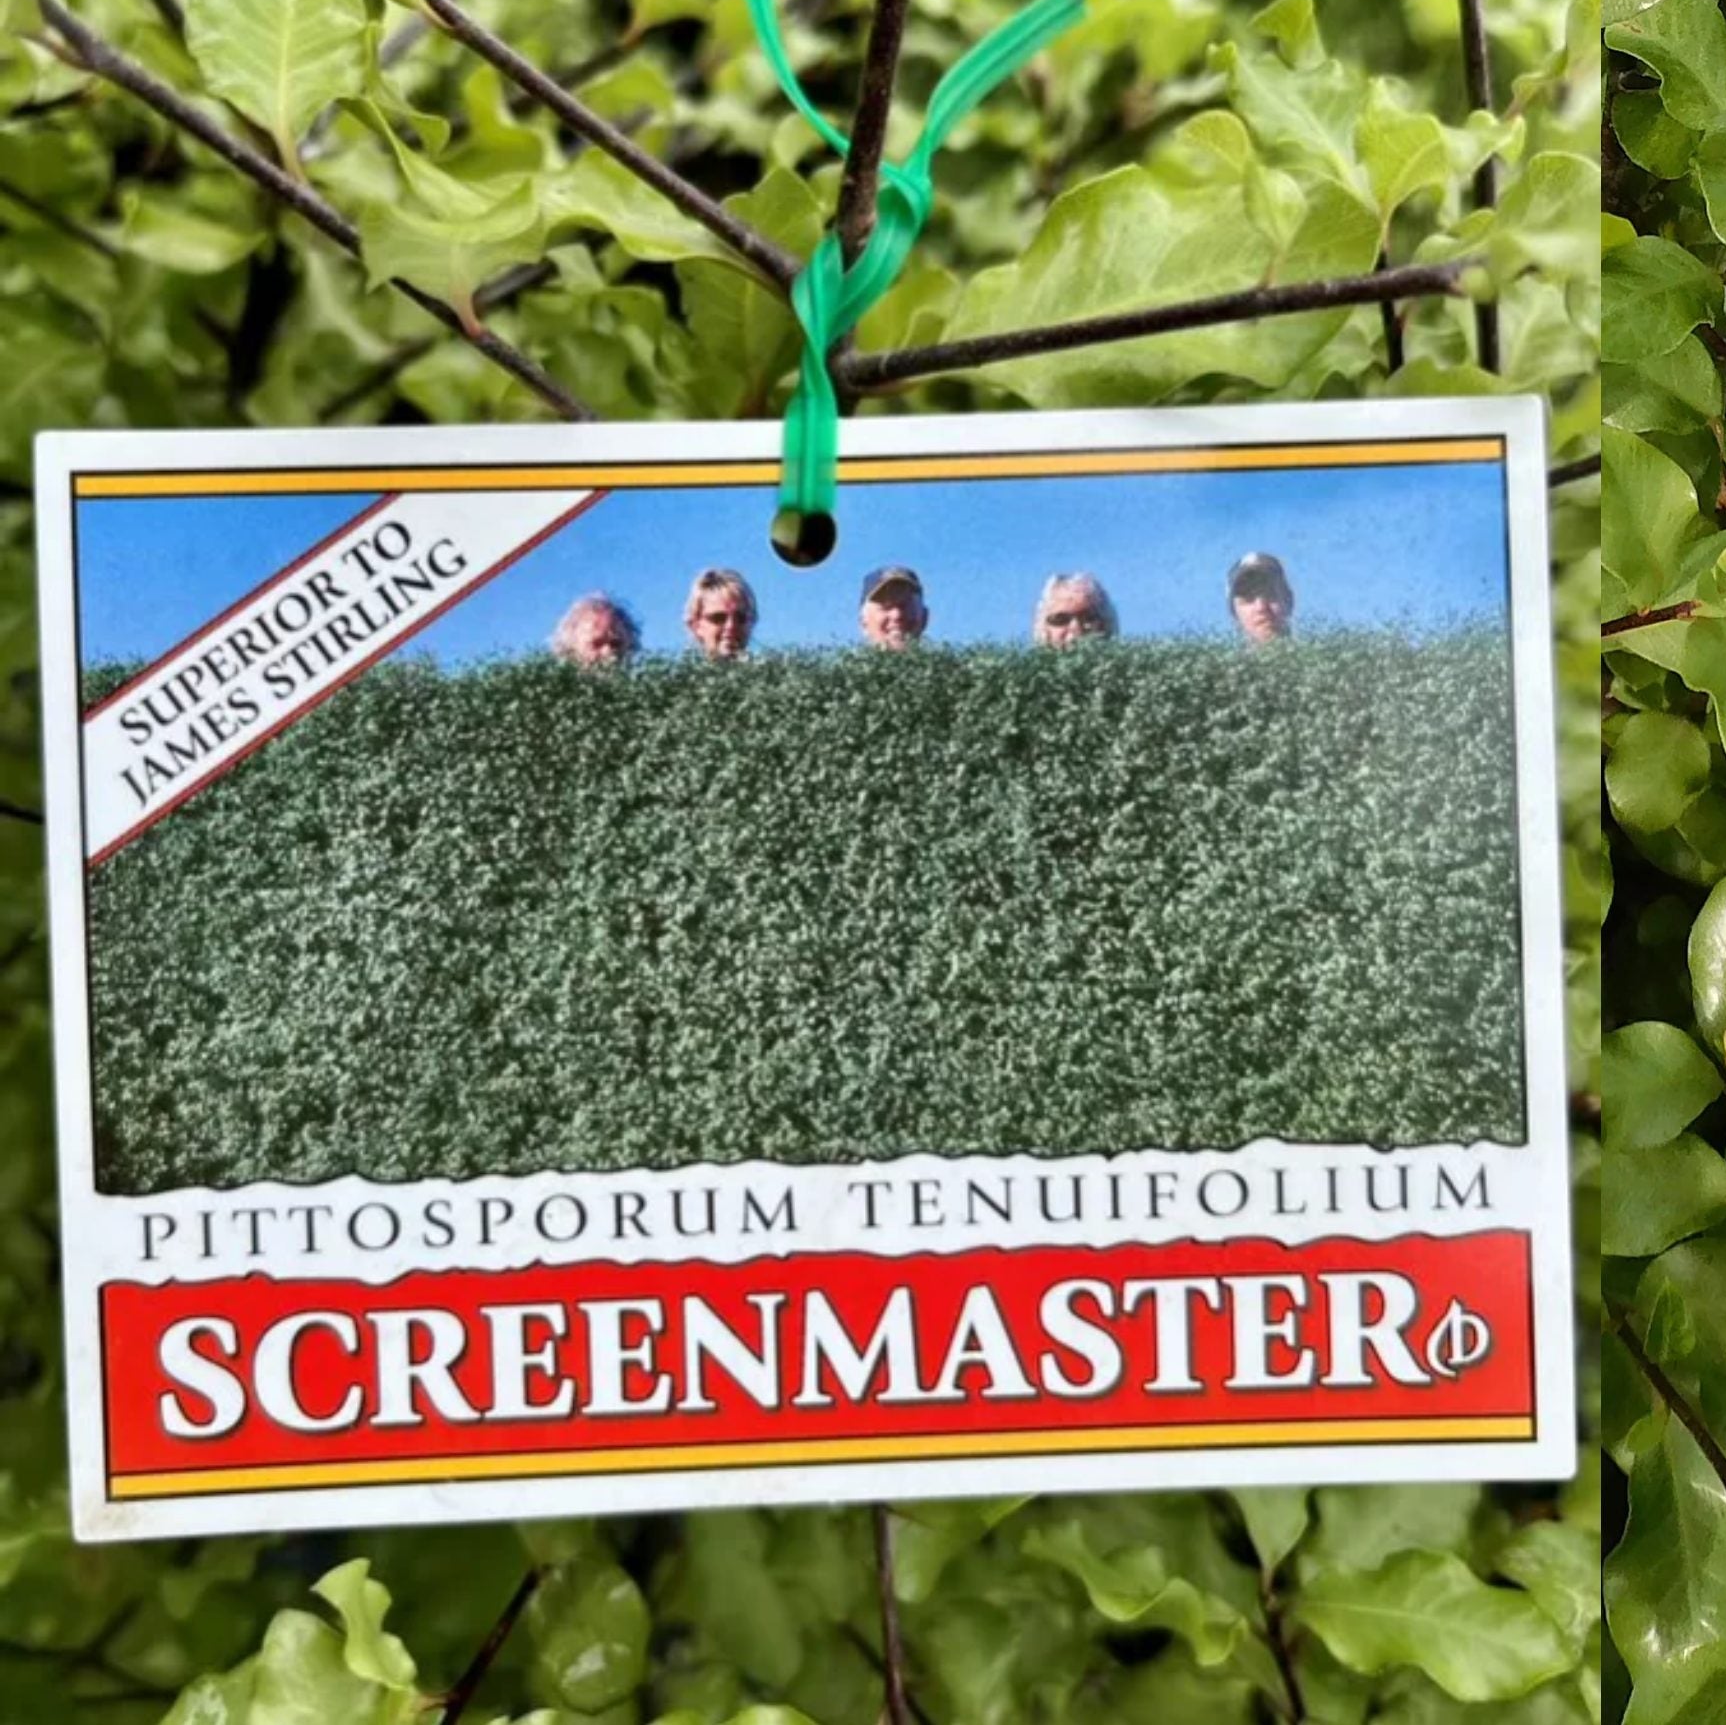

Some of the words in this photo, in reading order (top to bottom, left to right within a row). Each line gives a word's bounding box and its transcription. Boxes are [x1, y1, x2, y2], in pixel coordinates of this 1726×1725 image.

[118, 570, 347, 747] SUPERIOR
[341, 519, 412, 577] TO
[119, 687, 261, 808] JAMES
[261, 537, 469, 701] STIRLING
[139, 1185, 799, 1261] PITTOSPORUM
[847, 1164, 1496, 1228] TENUIFOLIUM
[156, 1270, 1433, 1440] SCREENMASTER
